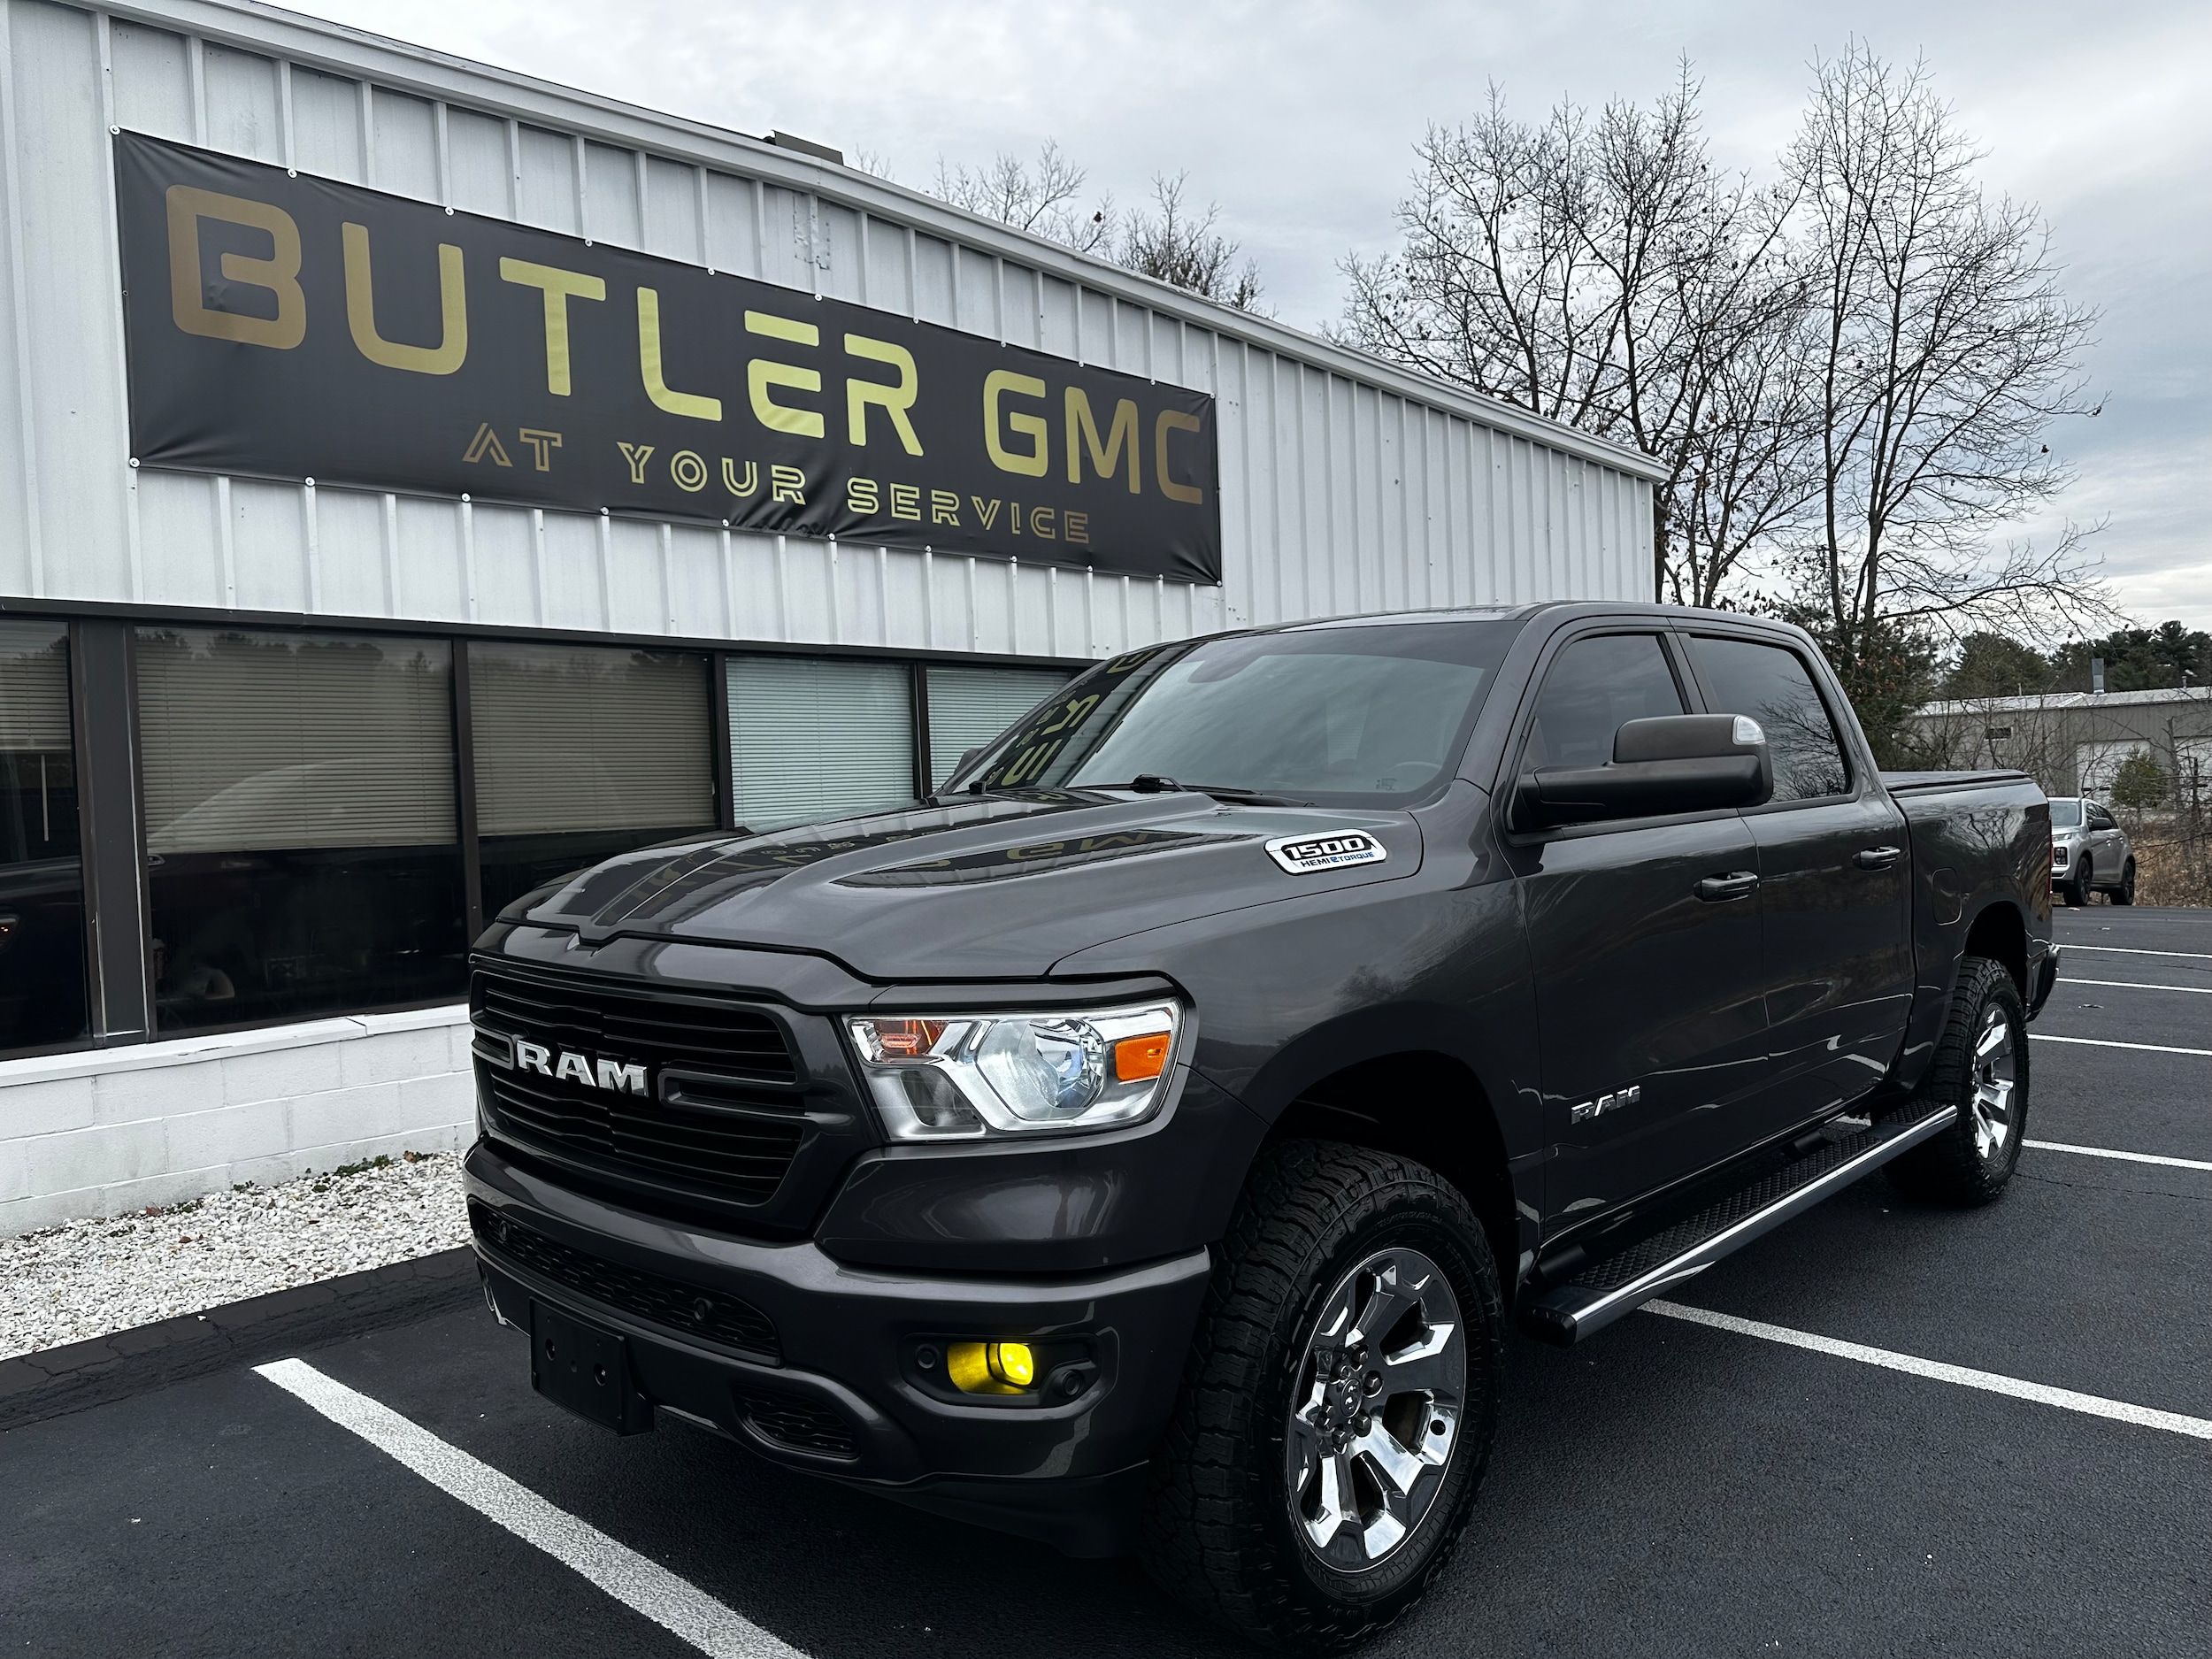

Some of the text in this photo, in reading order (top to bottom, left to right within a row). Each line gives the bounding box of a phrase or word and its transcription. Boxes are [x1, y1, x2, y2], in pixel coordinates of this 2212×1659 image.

[165, 185, 1202, 504] BUTLER GMC
[463, 422, 1089, 543] AT YOUR SERVICE
[1286, 837, 1365, 860] 1500
[1301, 856, 1331, 868] HEMI
[517, 1040, 649, 1098] RAM
[1571, 1085, 1640, 1125] RAM
